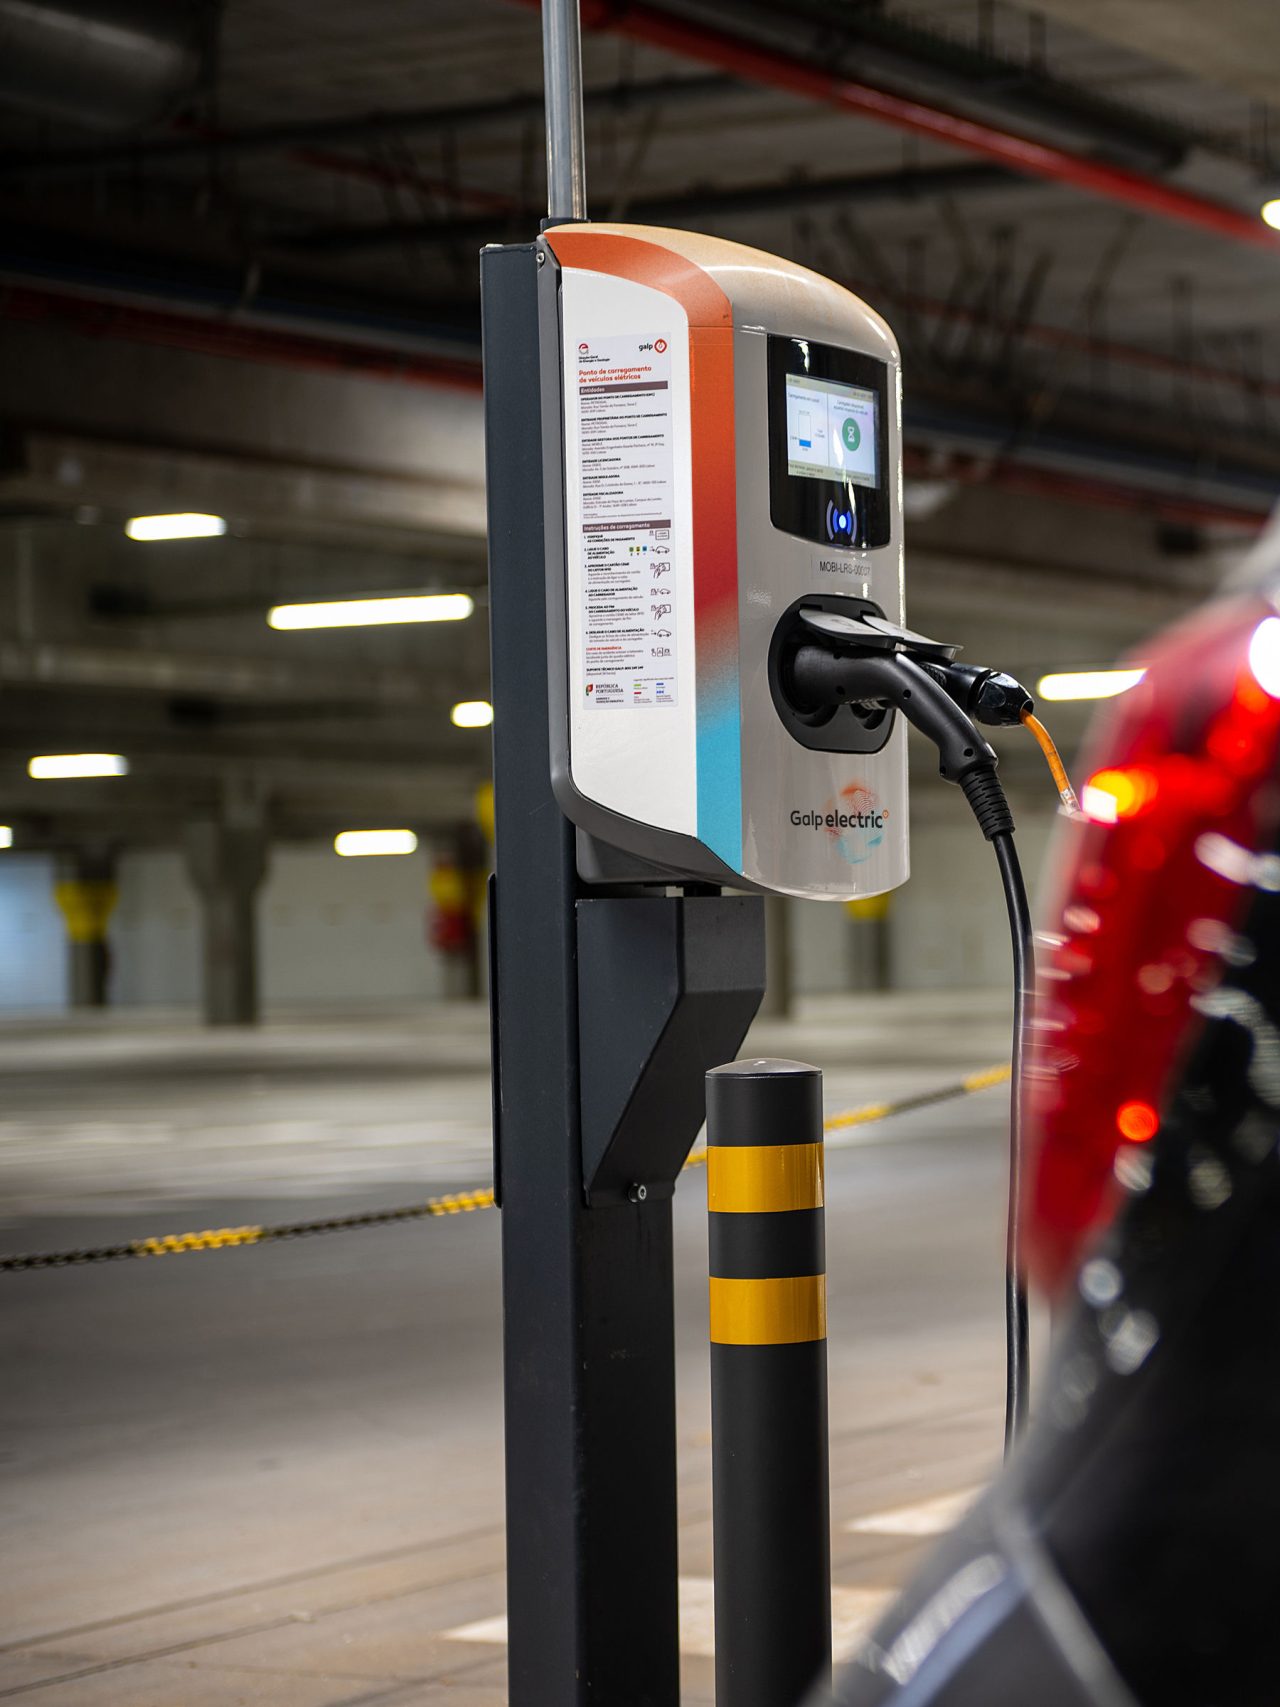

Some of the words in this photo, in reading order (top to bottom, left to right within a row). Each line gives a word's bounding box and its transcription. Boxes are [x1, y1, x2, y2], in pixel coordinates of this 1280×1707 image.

[638, 343, 653, 352] galp
[607, 365, 652, 374] carregamento
[588, 375, 613, 383] veículos
[614, 373, 641, 381] elétricos
[580, 386, 605, 394] Entidades
[583, 523, 609, 532] Instruções
[616, 522, 651, 530] carregamento
[790, 810, 824, 831] Galp
[825, 809, 883, 829] electric
